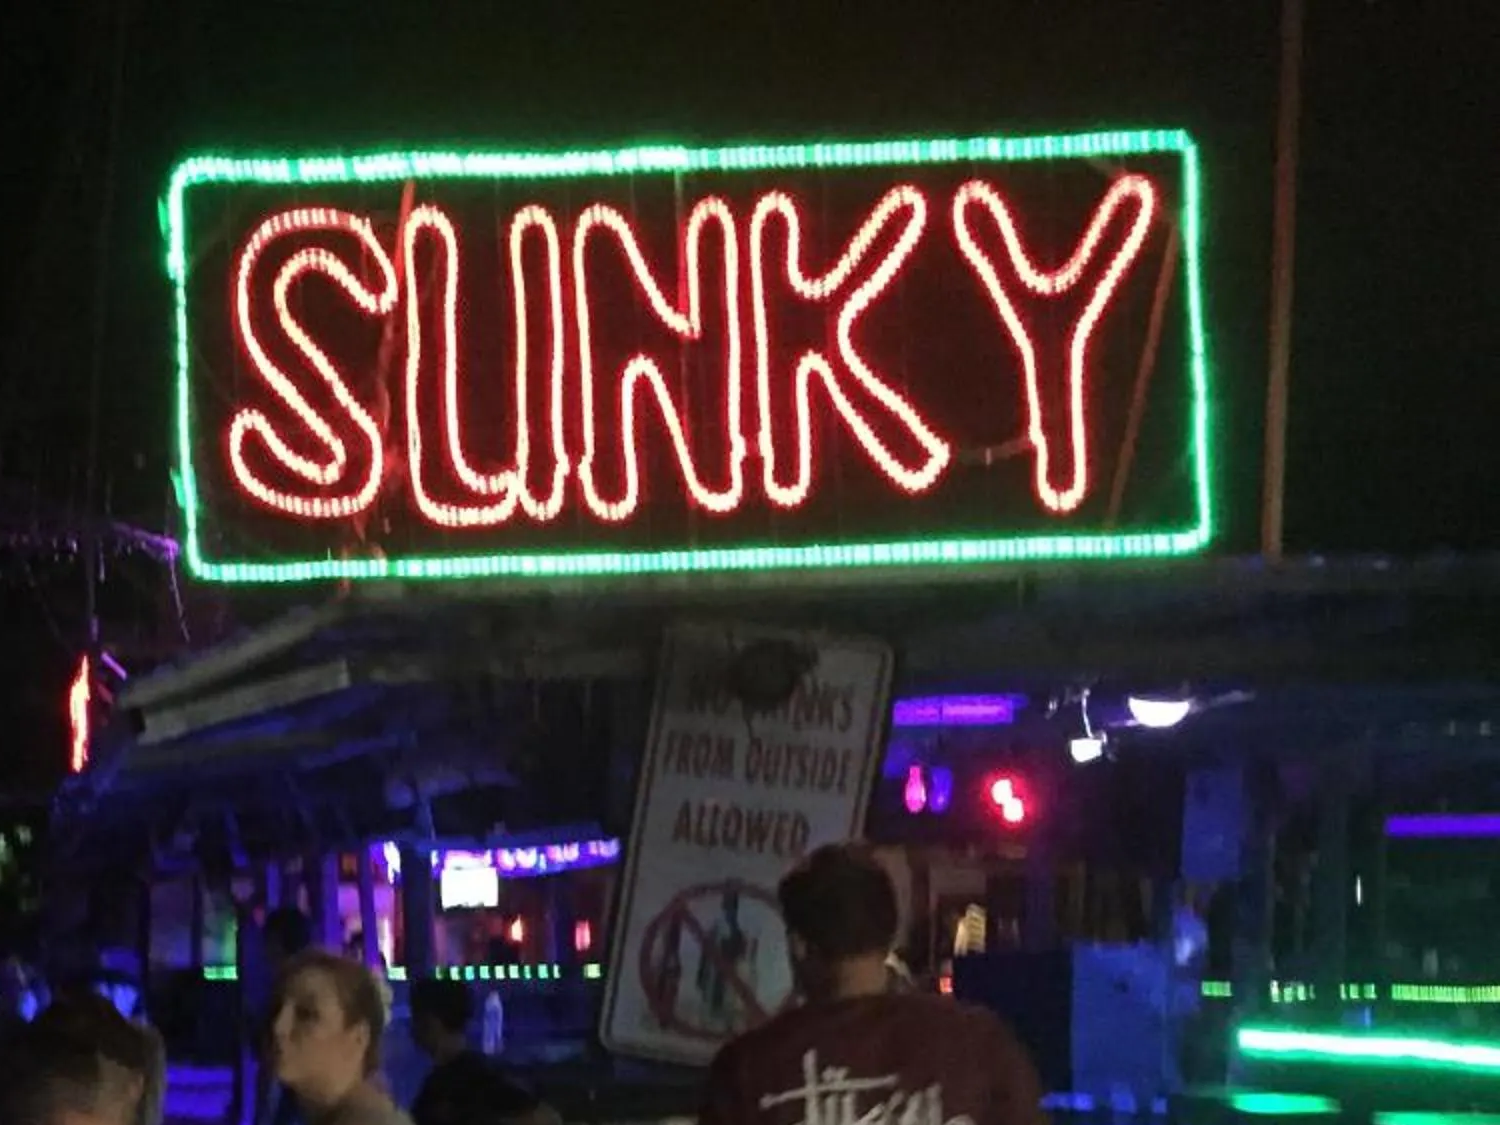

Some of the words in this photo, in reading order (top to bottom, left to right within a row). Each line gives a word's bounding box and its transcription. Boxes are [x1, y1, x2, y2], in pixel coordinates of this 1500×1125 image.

[229, 173, 1154, 527] SUNKY
[663, 729, 735, 779] FROM
[744, 736, 852, 793] OUTSIDE
[671, 798, 810, 854] ALLOWED
